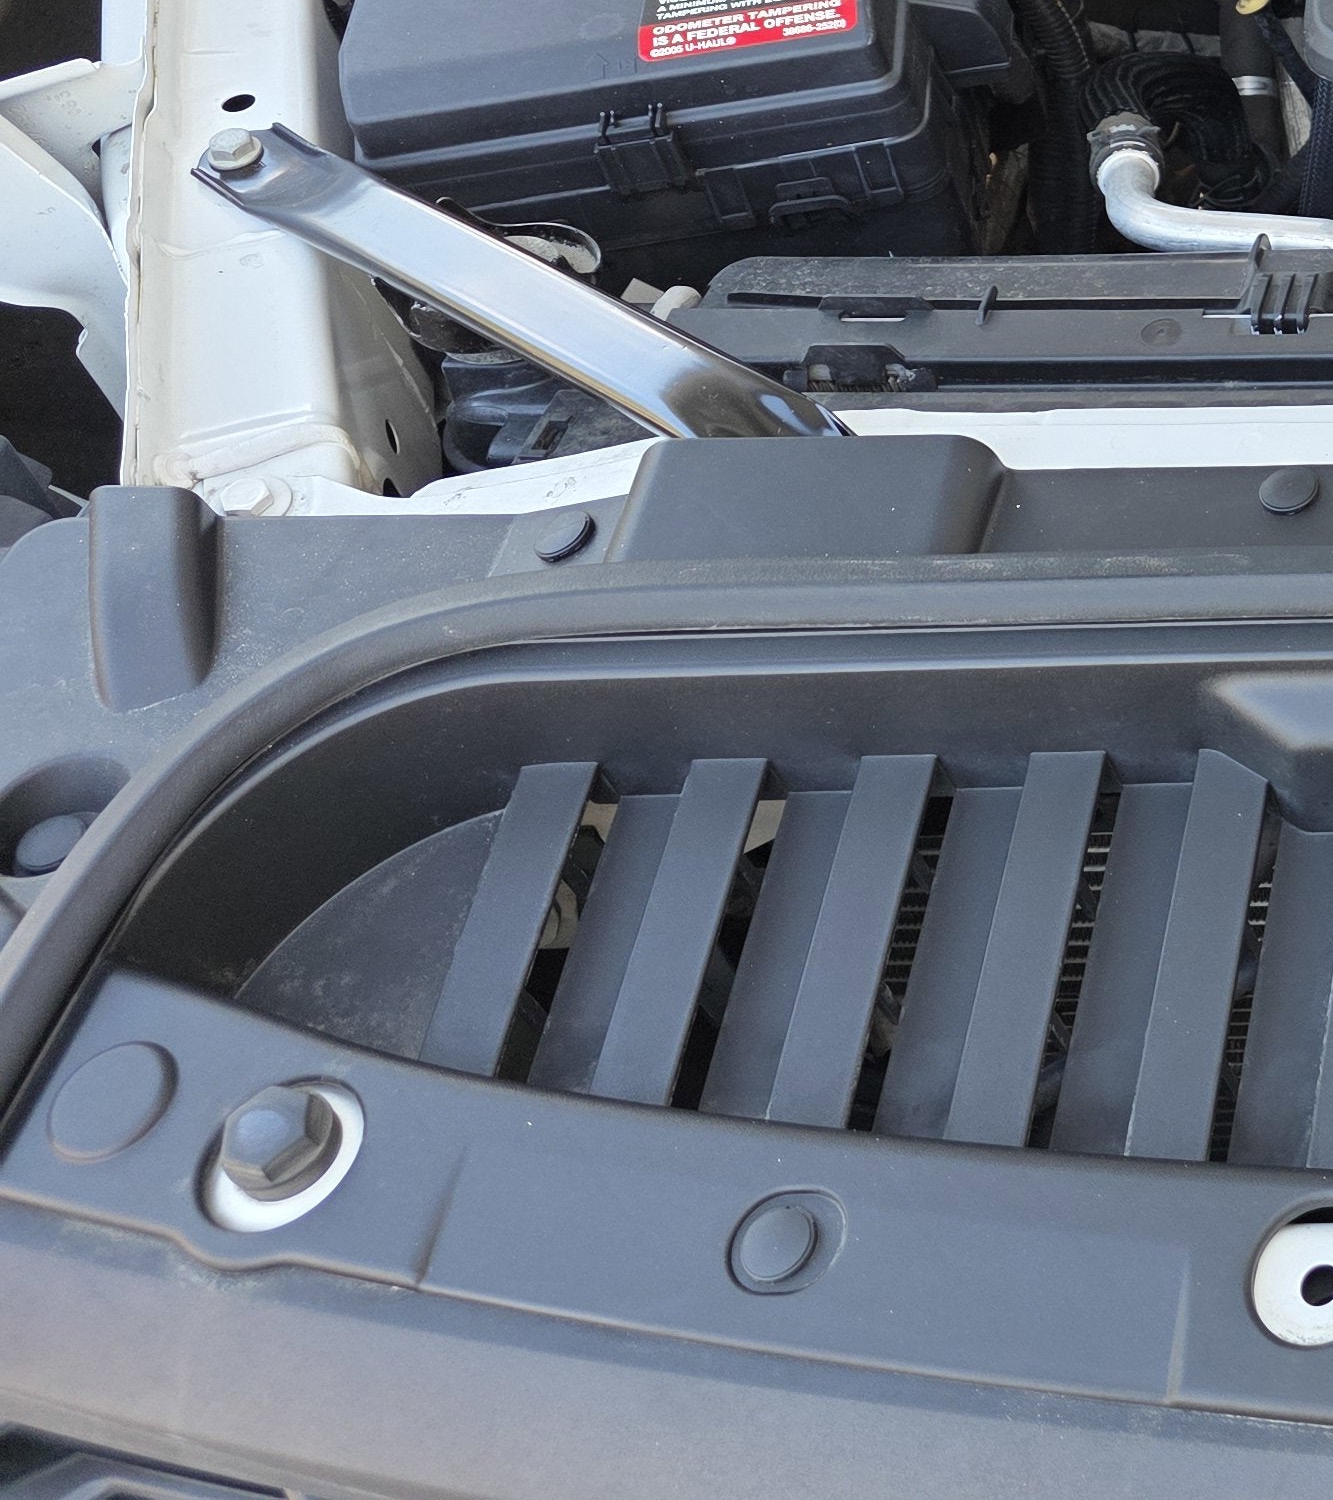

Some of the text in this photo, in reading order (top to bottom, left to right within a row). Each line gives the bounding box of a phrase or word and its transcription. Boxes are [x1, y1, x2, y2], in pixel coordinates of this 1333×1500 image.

[653, 0, 842, 35] ODOMETER TAMPERING
[653, 9, 841, 46] IS A FEDERAL OFFENSE.
[656, 4, 728, 20] TAMPERING
